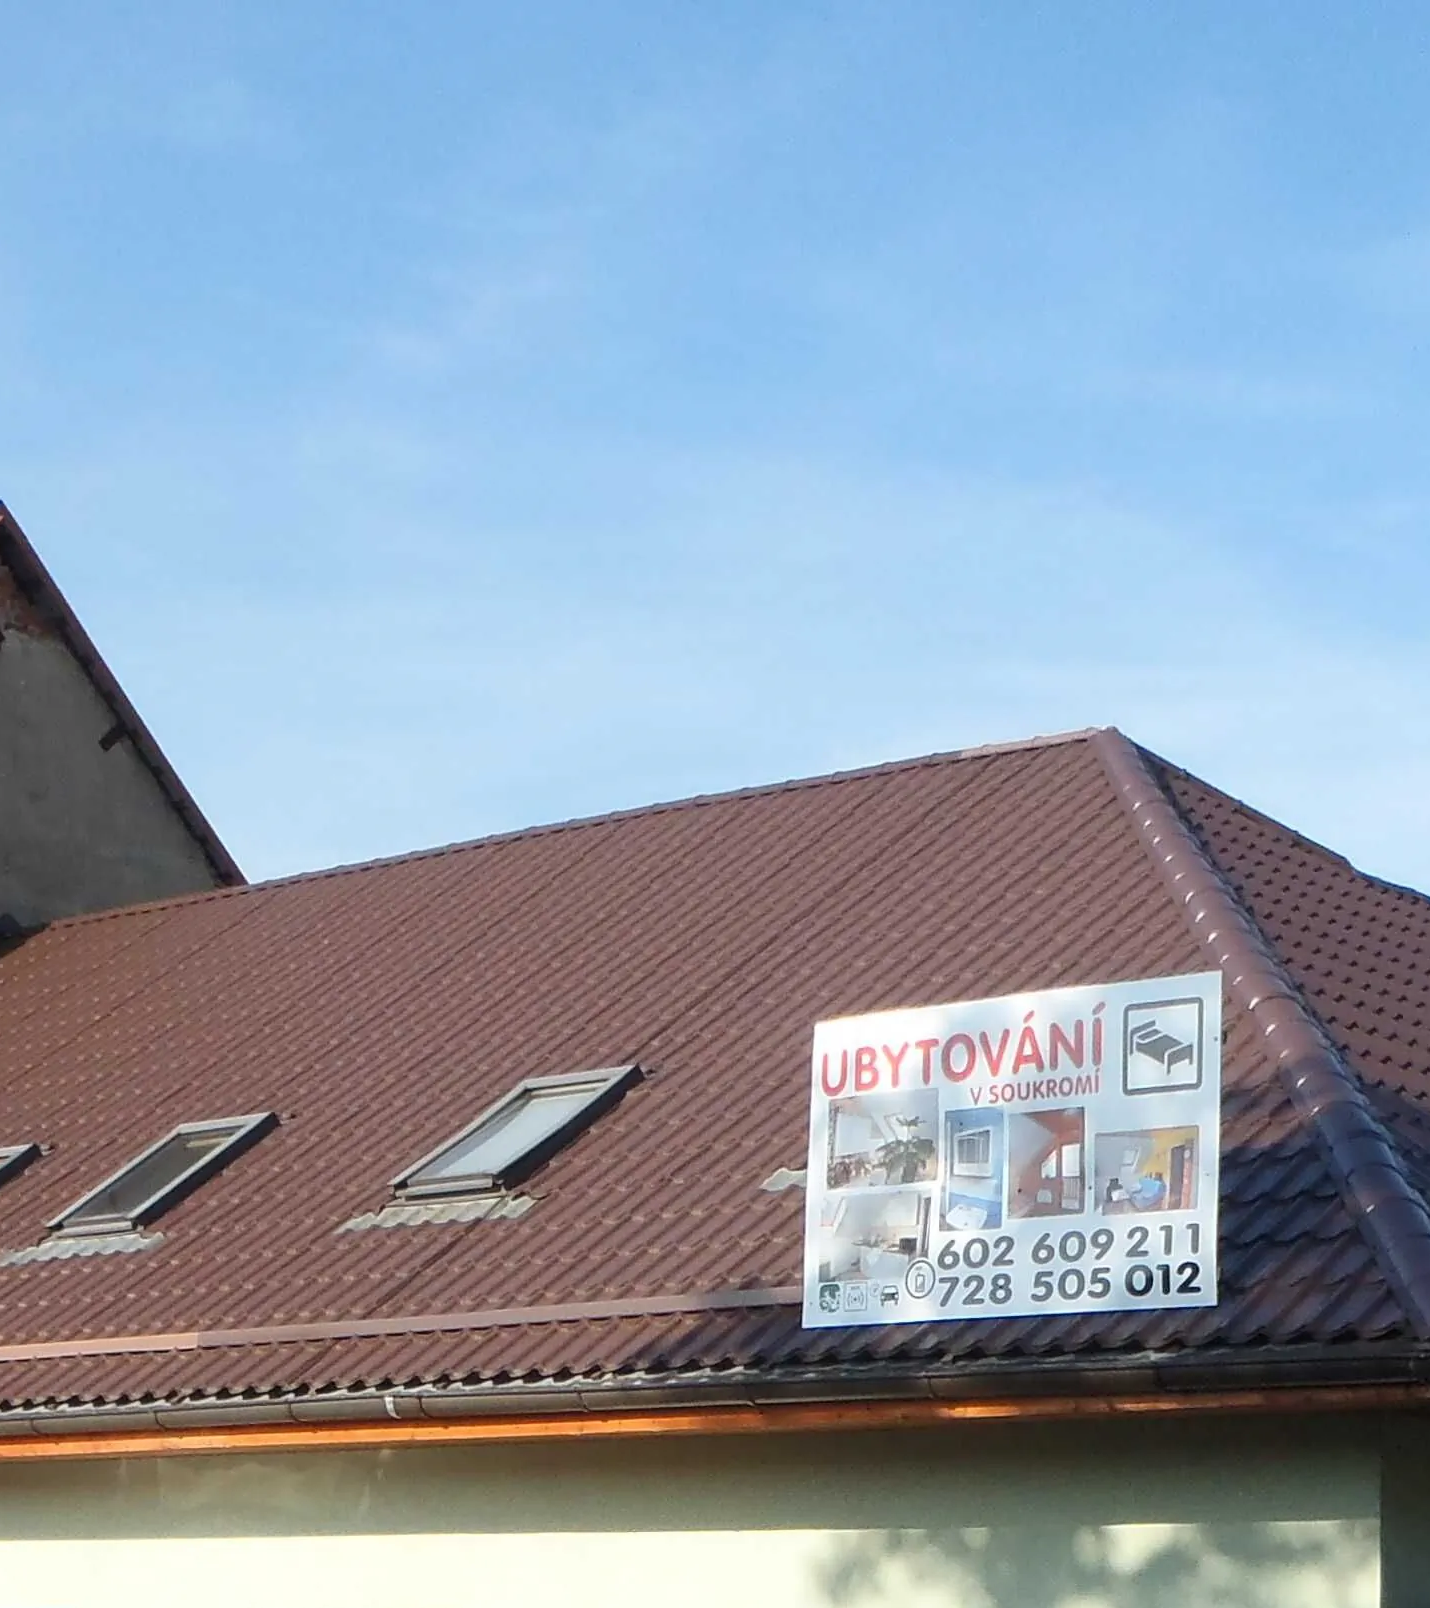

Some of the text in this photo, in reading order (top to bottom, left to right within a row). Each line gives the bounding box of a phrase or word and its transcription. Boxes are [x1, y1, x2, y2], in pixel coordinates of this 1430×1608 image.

[821, 1002, 1106, 1096] UBYTOVÁNÍ
[969, 1068, 1101, 1105] V SOUKROMÍ
[937, 1224, 1200, 1271] 602 609 211
[939, 1262, 1201, 1307] 728 505 012
